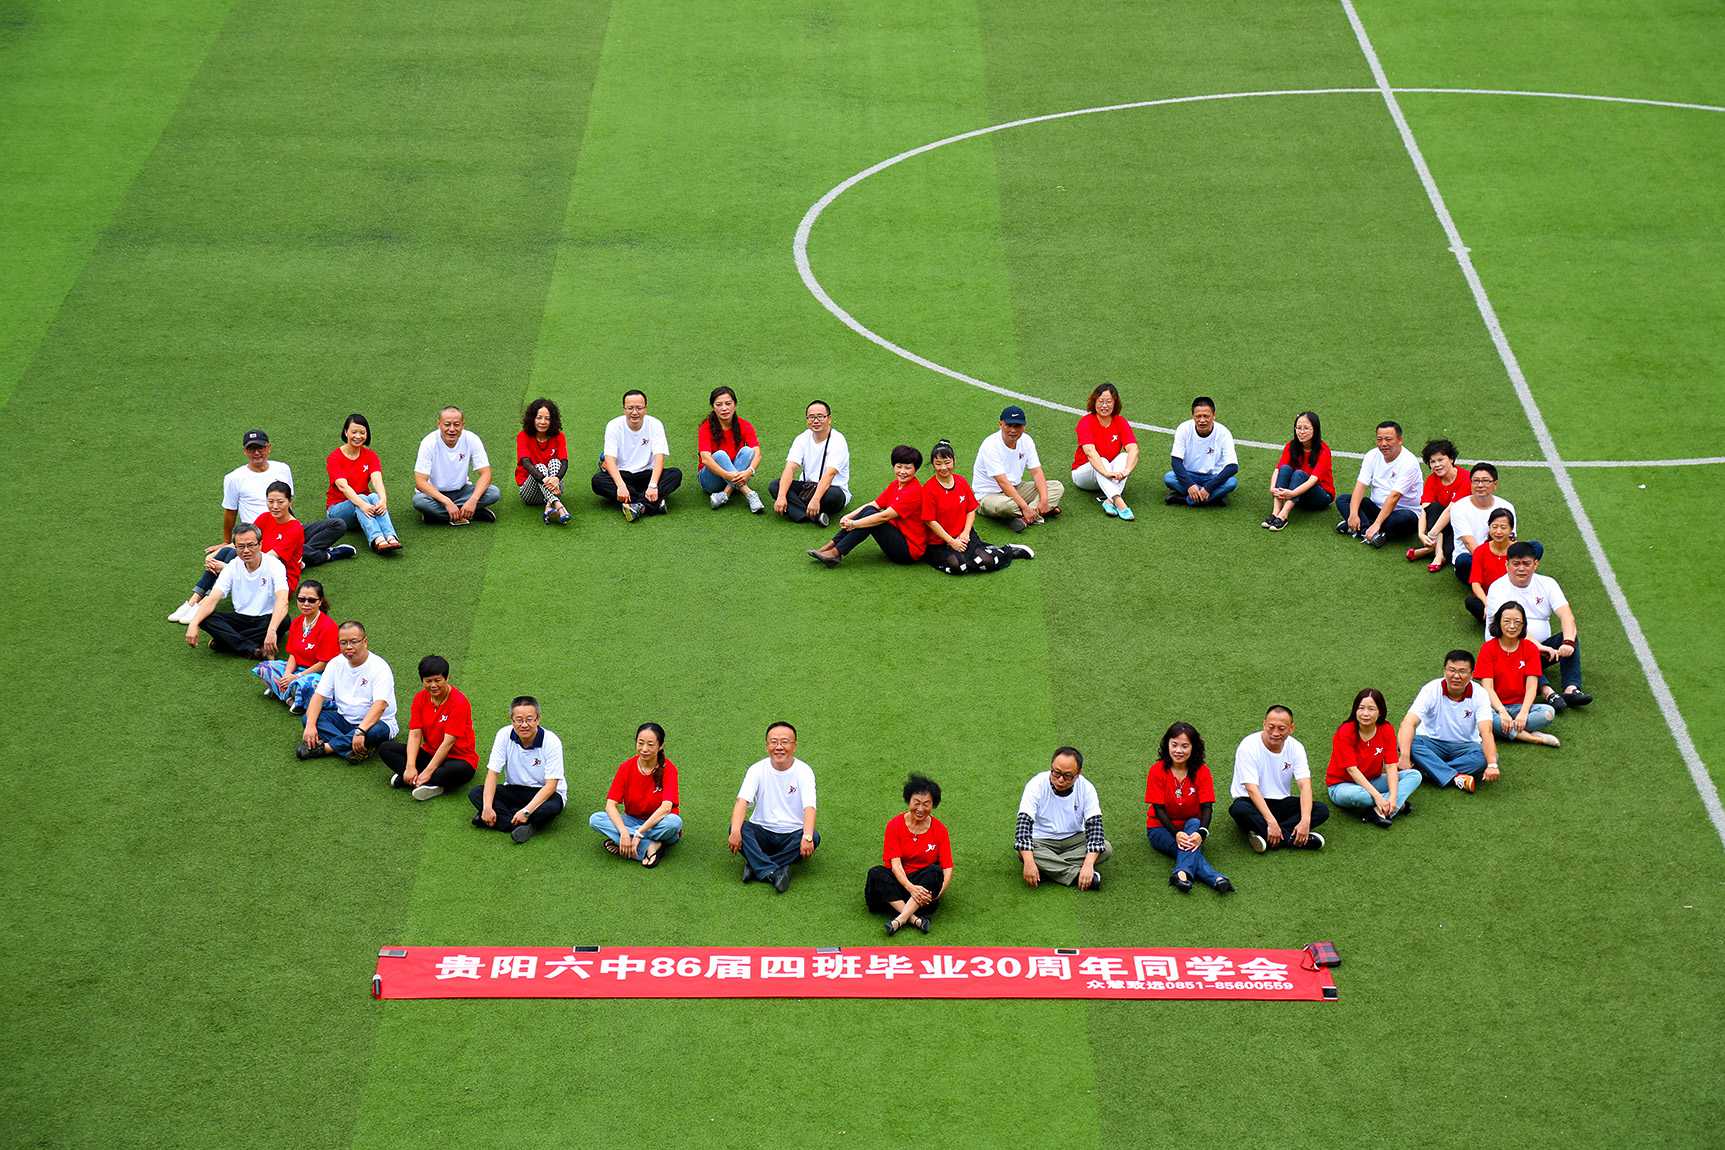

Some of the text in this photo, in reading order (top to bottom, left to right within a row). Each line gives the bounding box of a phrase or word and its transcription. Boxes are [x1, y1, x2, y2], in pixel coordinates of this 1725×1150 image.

[435, 955, 1289, 981] 贵阳六中86届四班毕业30周年同学会
